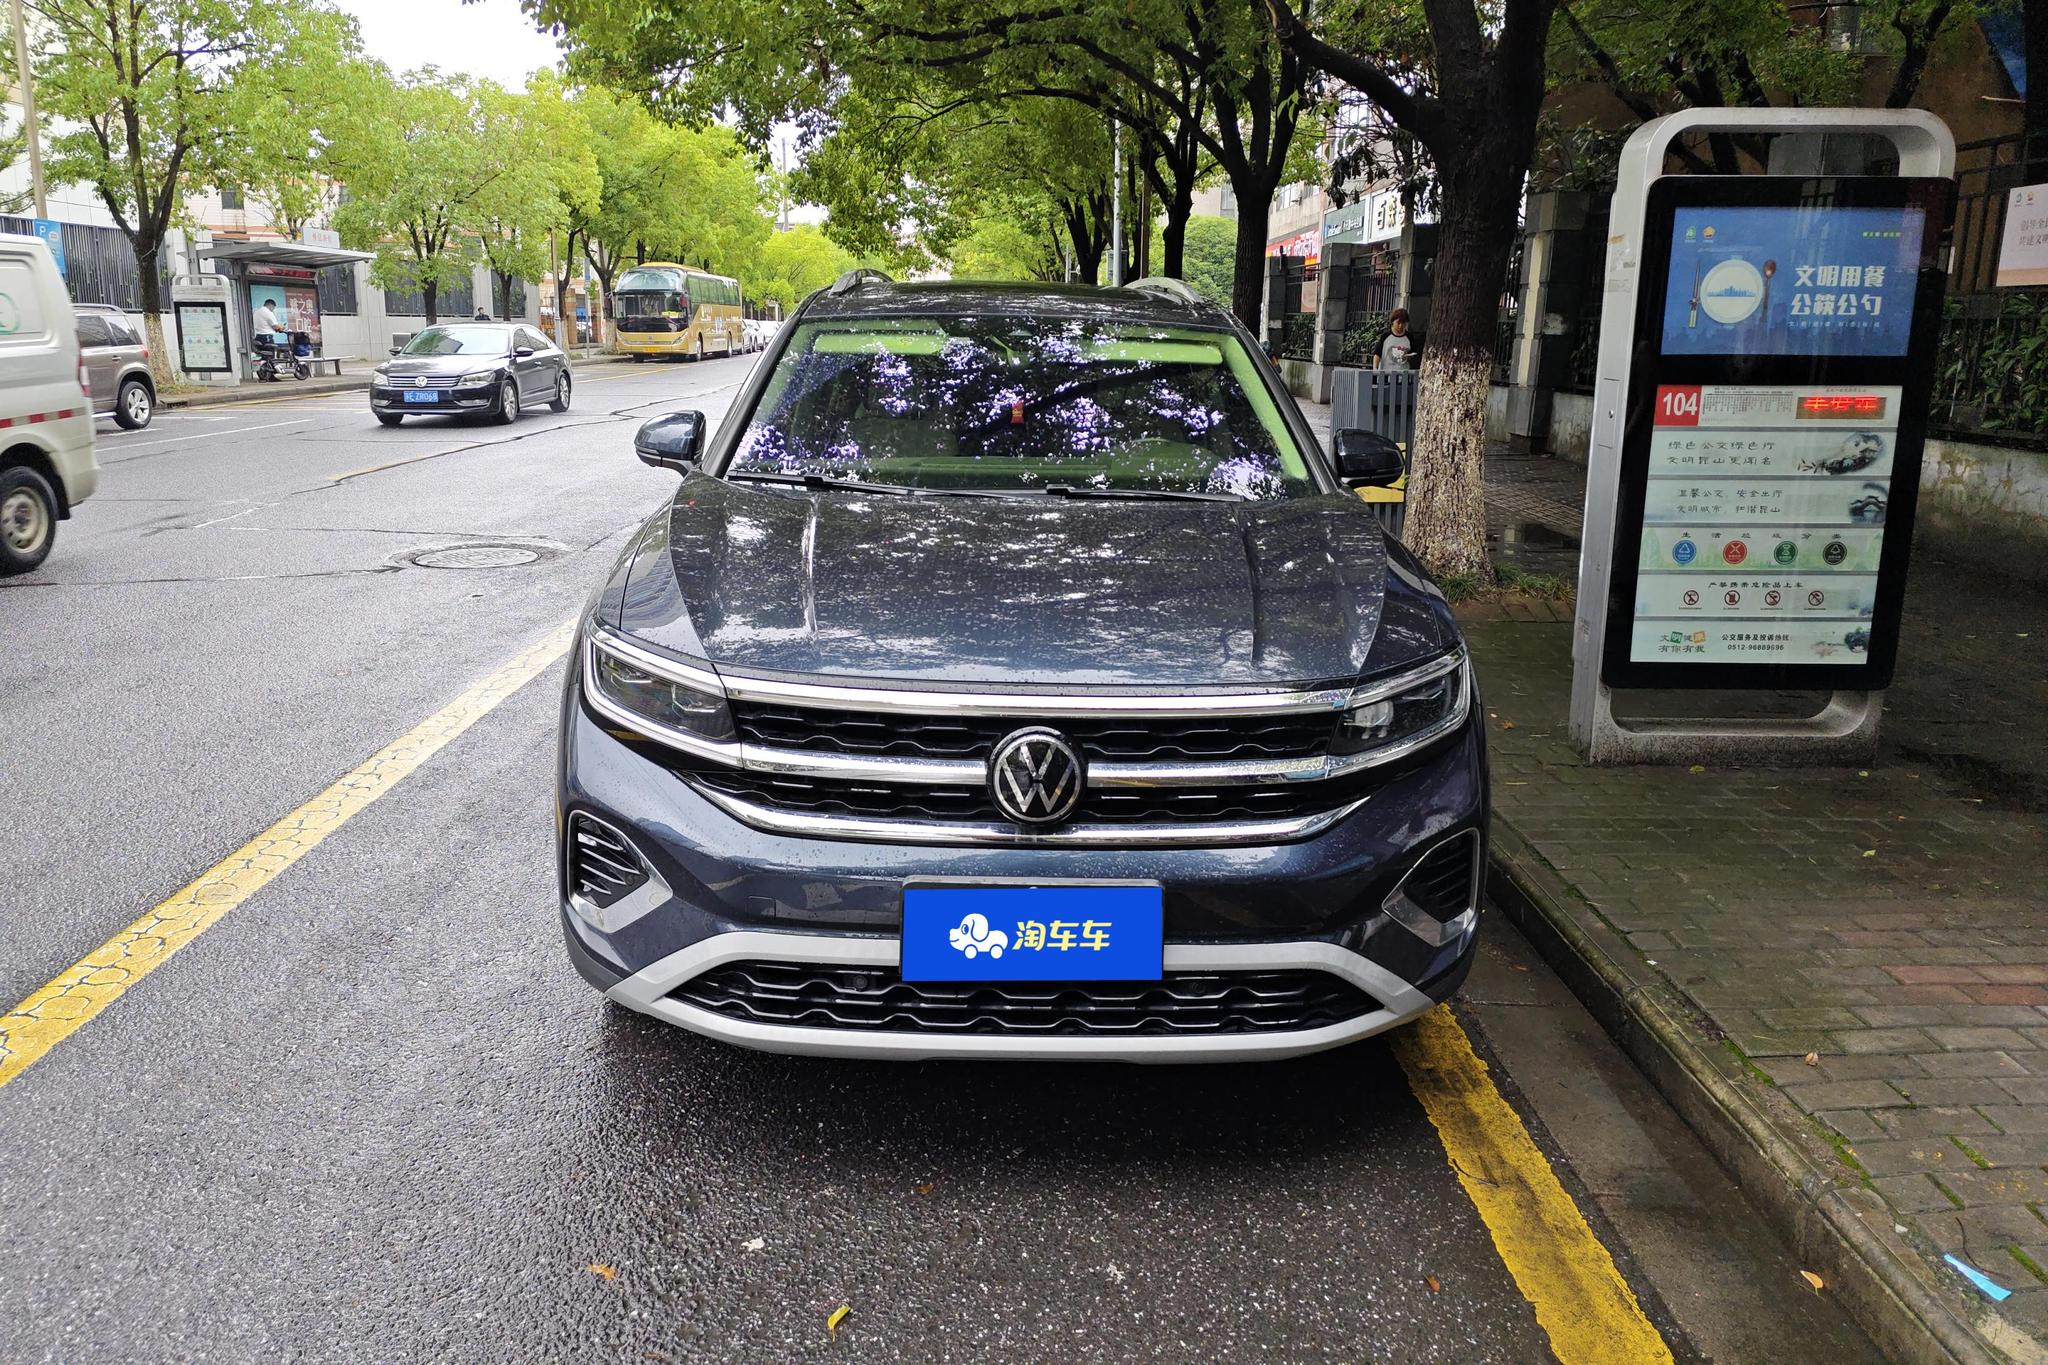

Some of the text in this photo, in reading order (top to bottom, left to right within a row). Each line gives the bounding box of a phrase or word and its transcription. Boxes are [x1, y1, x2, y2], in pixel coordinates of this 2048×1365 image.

[1794, 265, 1886, 287] 文明用餐
[1791, 293, 1882, 315] 公筷公勺
[1663, 392, 1698, 416] 104
